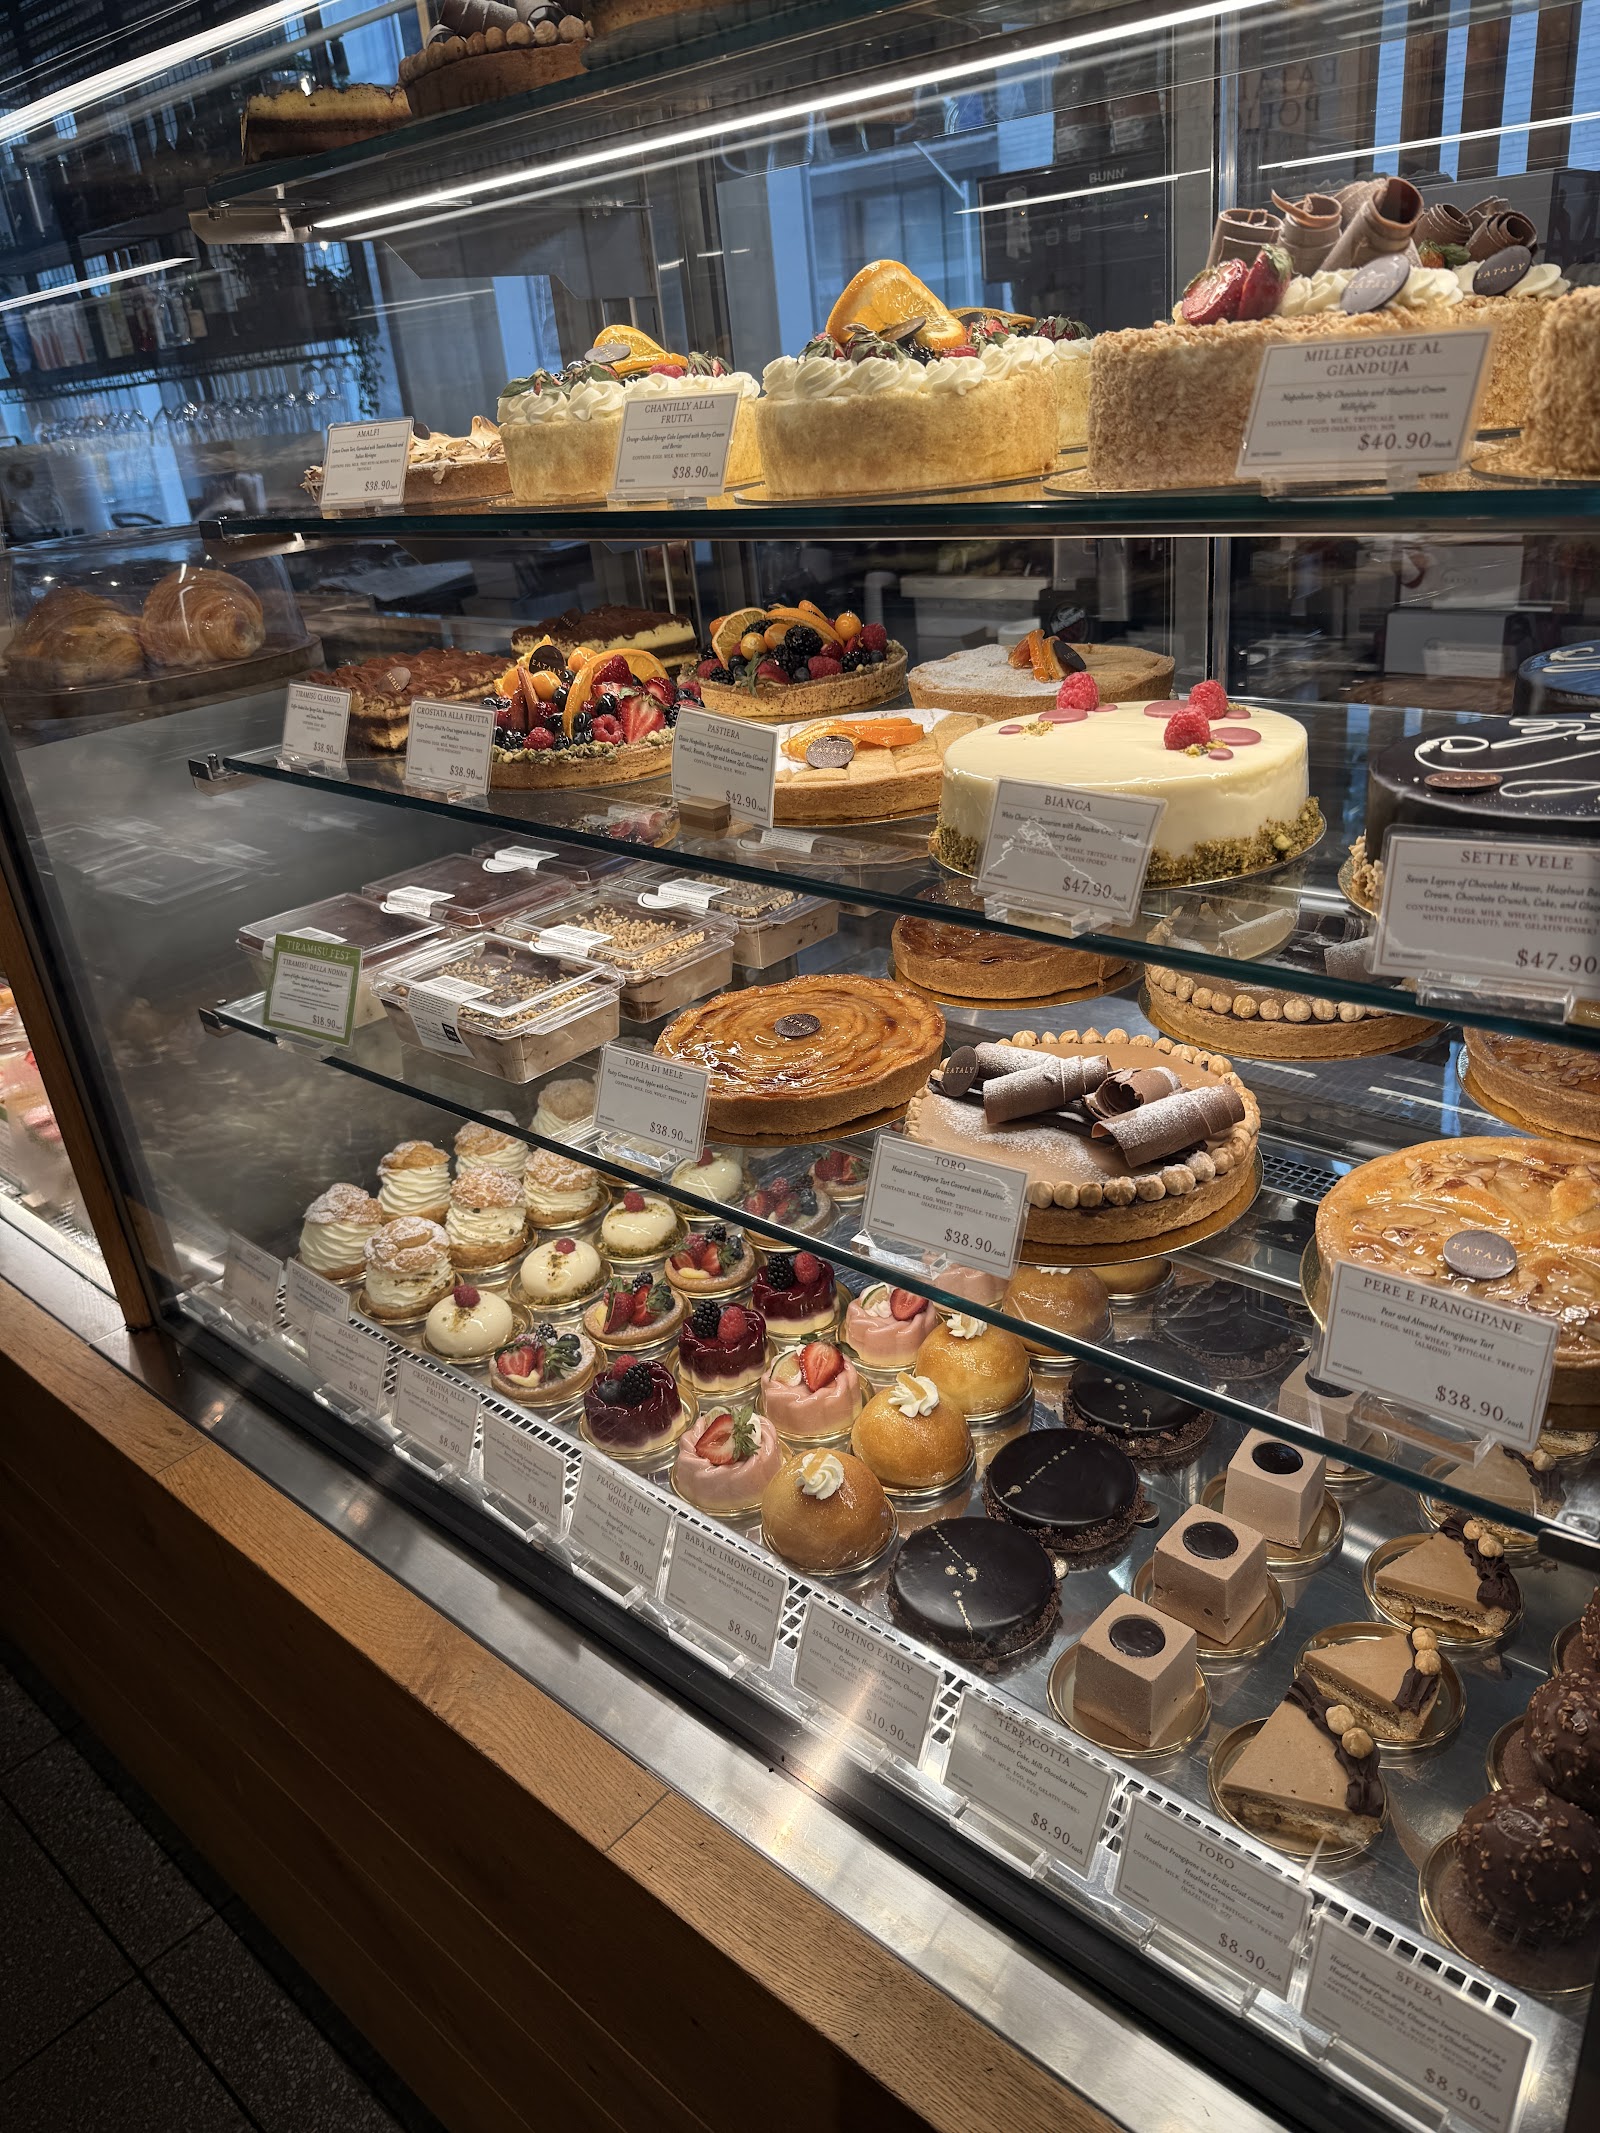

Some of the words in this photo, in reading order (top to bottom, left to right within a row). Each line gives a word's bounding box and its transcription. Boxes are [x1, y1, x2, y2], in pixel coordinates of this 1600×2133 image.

[1476, 261, 1526, 281] EATALY
[1303, 341, 1418, 363] MILLEFOGLIE
[1418, 339, 1445, 355] AL
[1324, 358, 1412, 380] GIANDUJA
[643, 400, 692, 413] CHANTILLY
[691, 399, 716, 410] ALLA
[660, 412, 694, 424] FRUTTA
[356, 427, 380, 438] AMALFI
[531, 659, 563, 676] EATALY
[416, 706, 447, 718] CROSTATA
[447, 710, 464, 721] ALLA
[464, 712, 489, 724] FRUTTA
[706, 723, 740, 740] PASTIERA
[1043, 794, 1093, 812] BIANCA
[1459, 849, 1519, 867] SETTE
[1525, 853, 1574, 871] VELE
[1404, 874, 1429, 887] Seven
[1429, 875, 1456, 889] Layers
[1456, 877, 1466, 890] of
[1467, 878, 1508, 893] Chocolate
[1545, 883, 1584, 899] Hazelnut
[1422, 888, 1453, 903] Cream,
[1454, 891, 1495, 906] Chocolate
[1559, 898, 1577, 912] and
[328, 947, 351, 961] FEST
[623, 1055, 650, 1071] TORTA
[651, 1063, 661, 1074] DI
[661, 1066, 684, 1081] MELE
[932, 1154, 967, 1172] TORO
[890, 1164, 913, 1178] Hazelnut
[912, 1170, 939, 1185] Frangipane
[970, 1185, 982, 1196] with
[1452, 1242, 1515, 1266] EATALY
[1362, 1276, 1402, 1299] PERE
[1405, 1289, 1416, 1303] E
[1419, 1293, 1524, 1336] FRANGIPANE
[1379, 1306, 1396, 1321] Pear
[1396, 1311, 1411, 1325] and
[1410, 1316, 1438, 1333] Almond
[1437, 1324, 1479, 1346] Frangipane
[1478, 1337, 1495, 1351] Tart
[449, 1388, 466, 1404] ALLA
[595, 1472, 628, 1501] FRAGOLA
[632, 1497, 652, 1517] LIME
[606, 1491, 635, 1517] MOUSSE
[705, 1542, 718, 1557] AL
[718, 1549, 775, 1589] LIMONCELLO
[829, 1618, 875, 1653] TORTINO
[876, 1645, 913, 1675] EATALY
[995, 1715, 1072, 1768] TERRACOTTA
[991, 1734, 1016, 1755] Chocolate
[1030, 1758, 1043, 1771] Milk
[1042, 1765, 1068, 1786] Chocolate
[1015, 1760, 1037, 1778] Caramel
[1142, 1831, 1169, 1854] Hazelnut
[1167, 1846, 1200, 1872] Frangipane
[1211, 1871, 1230, 1890] Frolla
[1229, 1882, 1247, 1899] Crust
[1195, 1839, 1236, 1871] TORO
[1183, 1866, 1210, 1889] Hazelnut
[1394, 1968, 1445, 2007] SFERA
